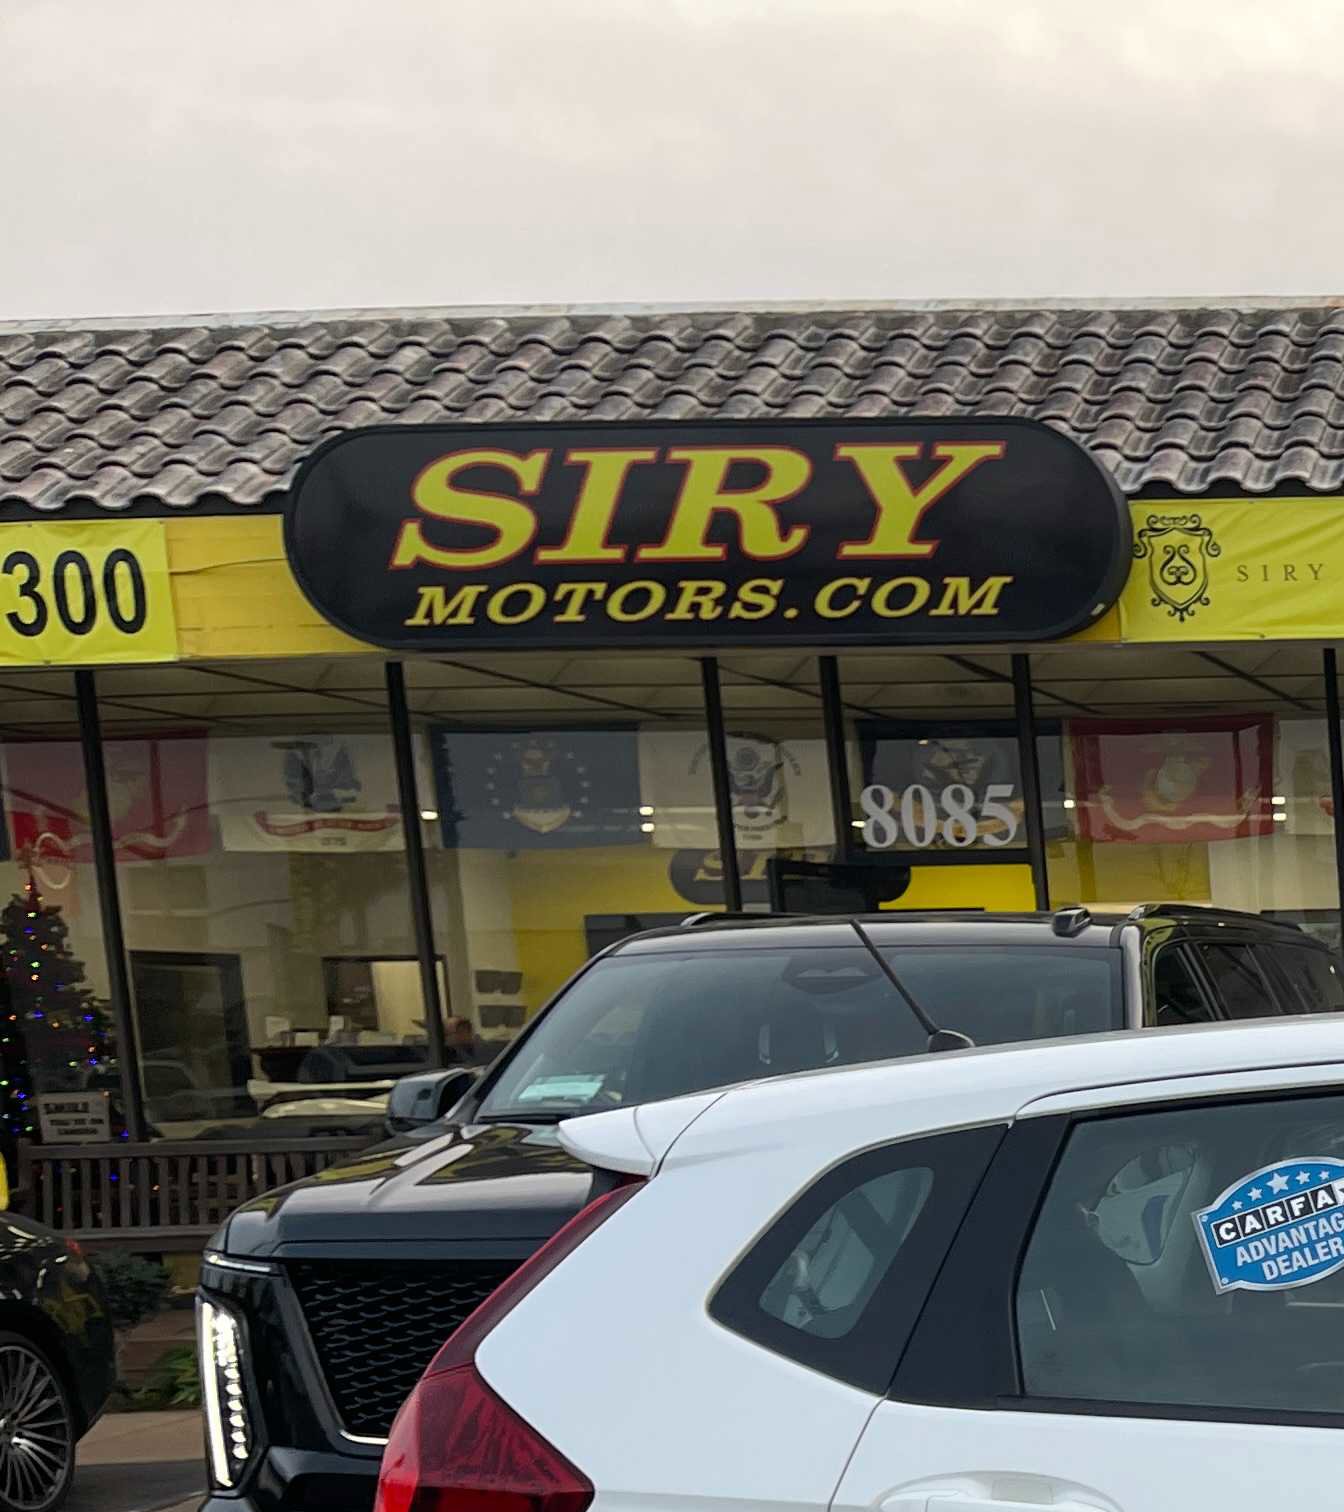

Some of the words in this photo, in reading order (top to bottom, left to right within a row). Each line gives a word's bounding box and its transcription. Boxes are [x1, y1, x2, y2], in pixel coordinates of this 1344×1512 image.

[390, 440, 1006, 569] SIRY
[2, 548, 147, 637] 300
[404, 575, 1013, 626] MOTORS.COM
[1236, 563, 1323, 582] SIRY
[861, 784, 1017, 847] 8085
